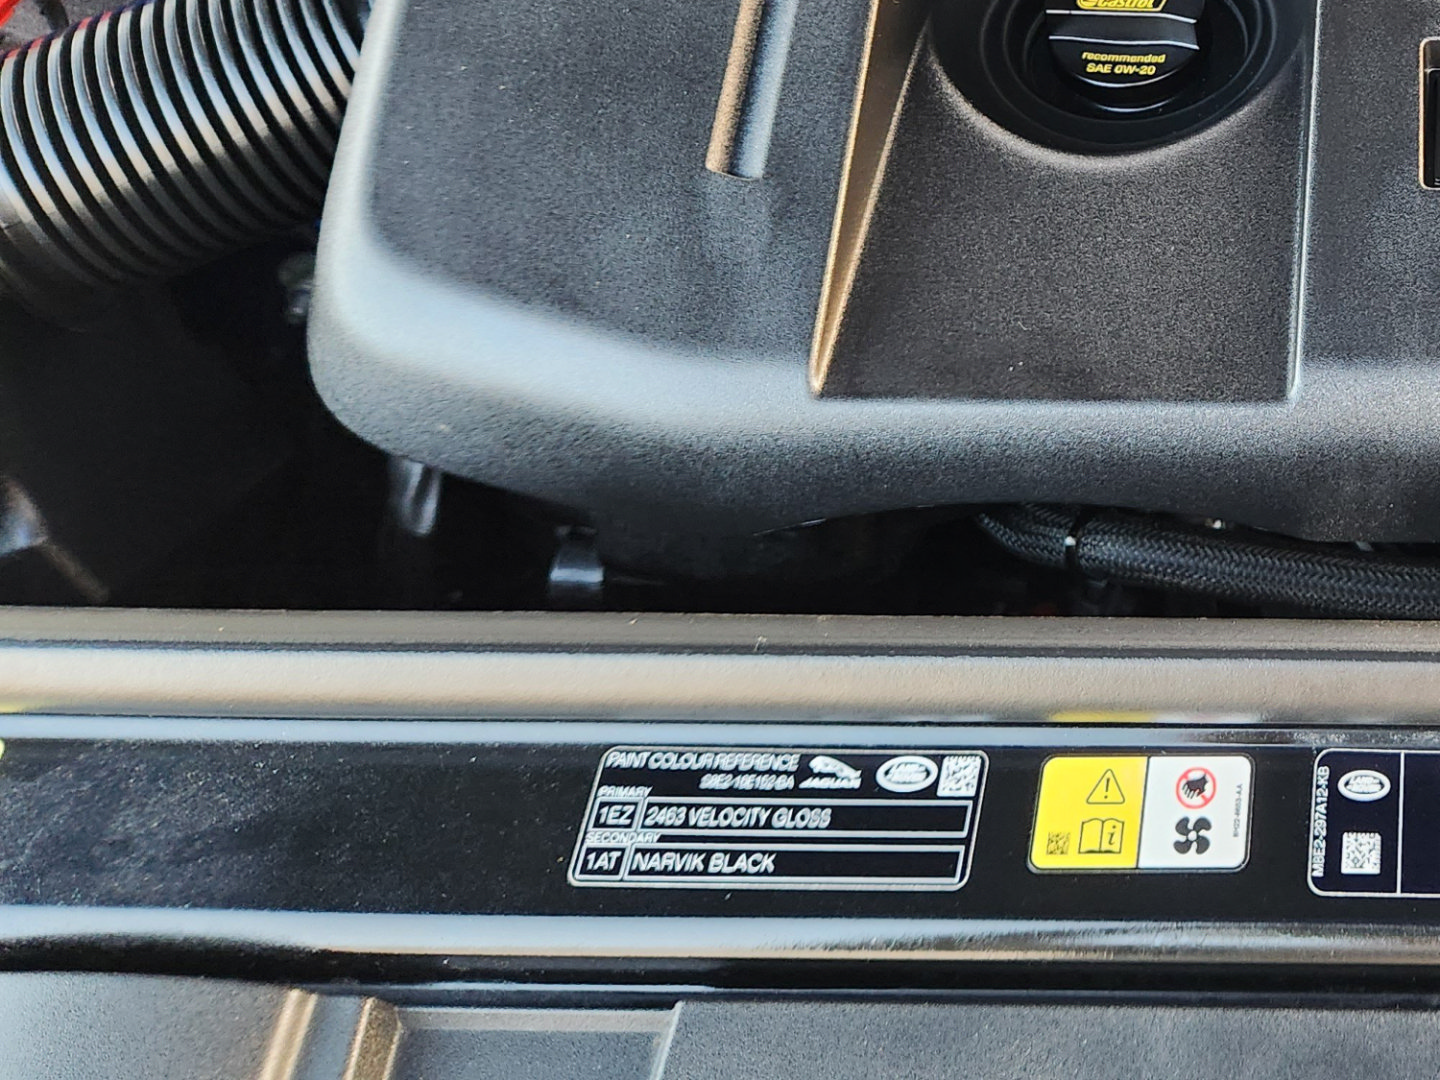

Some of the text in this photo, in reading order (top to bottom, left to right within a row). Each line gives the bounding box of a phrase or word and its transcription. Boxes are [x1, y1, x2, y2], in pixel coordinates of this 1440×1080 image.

[1082, 52, 1166, 63] recommended
[1086, 63, 1157, 75] SAE 0W-20
[605, 751, 801, 772] PAINT COLOUR REFERENCE
[597, 785, 652, 798] PRIMARY
[598, 805, 635, 826] 1EZ
[643, 806, 832, 829] 2463 VELOCITY GLOSS
[585, 831, 661, 844] SECONDARY
[586, 853, 623, 872] 1AT
[631, 853, 777, 874] NARVIK BLACK
